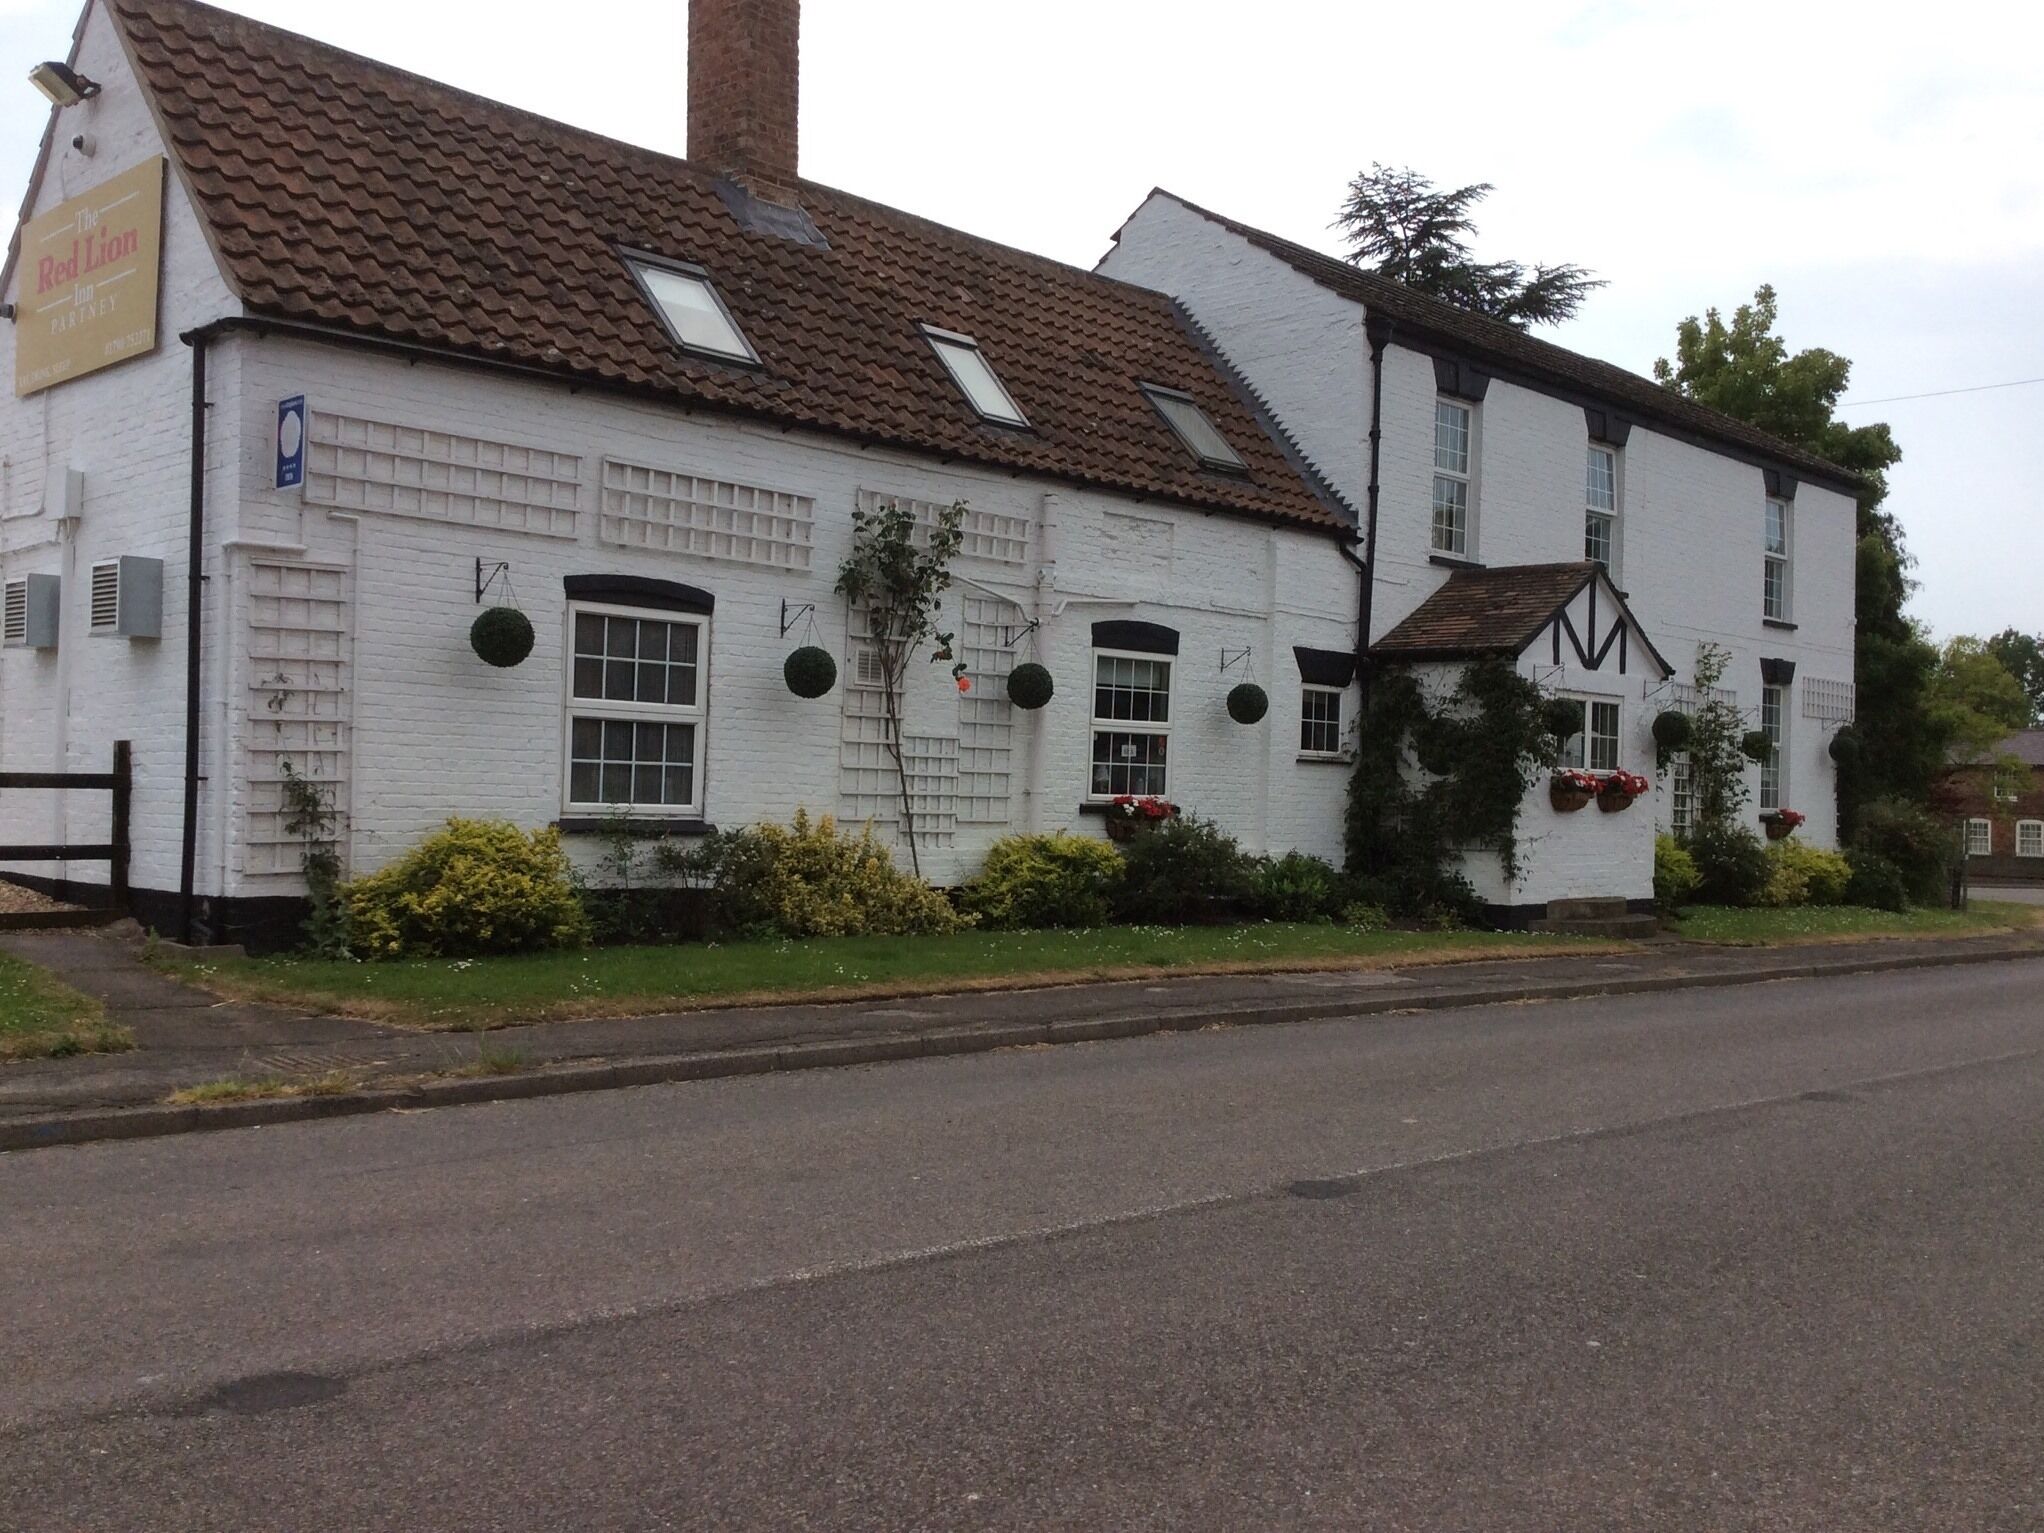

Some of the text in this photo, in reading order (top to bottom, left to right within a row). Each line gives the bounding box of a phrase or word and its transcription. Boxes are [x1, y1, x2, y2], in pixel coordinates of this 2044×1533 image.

[74, 207, 98, 233] The
[37, 225, 138, 295] Red Lion
[73, 283, 94, 307] Inn
[50, 292, 118, 335] PARTNEY
